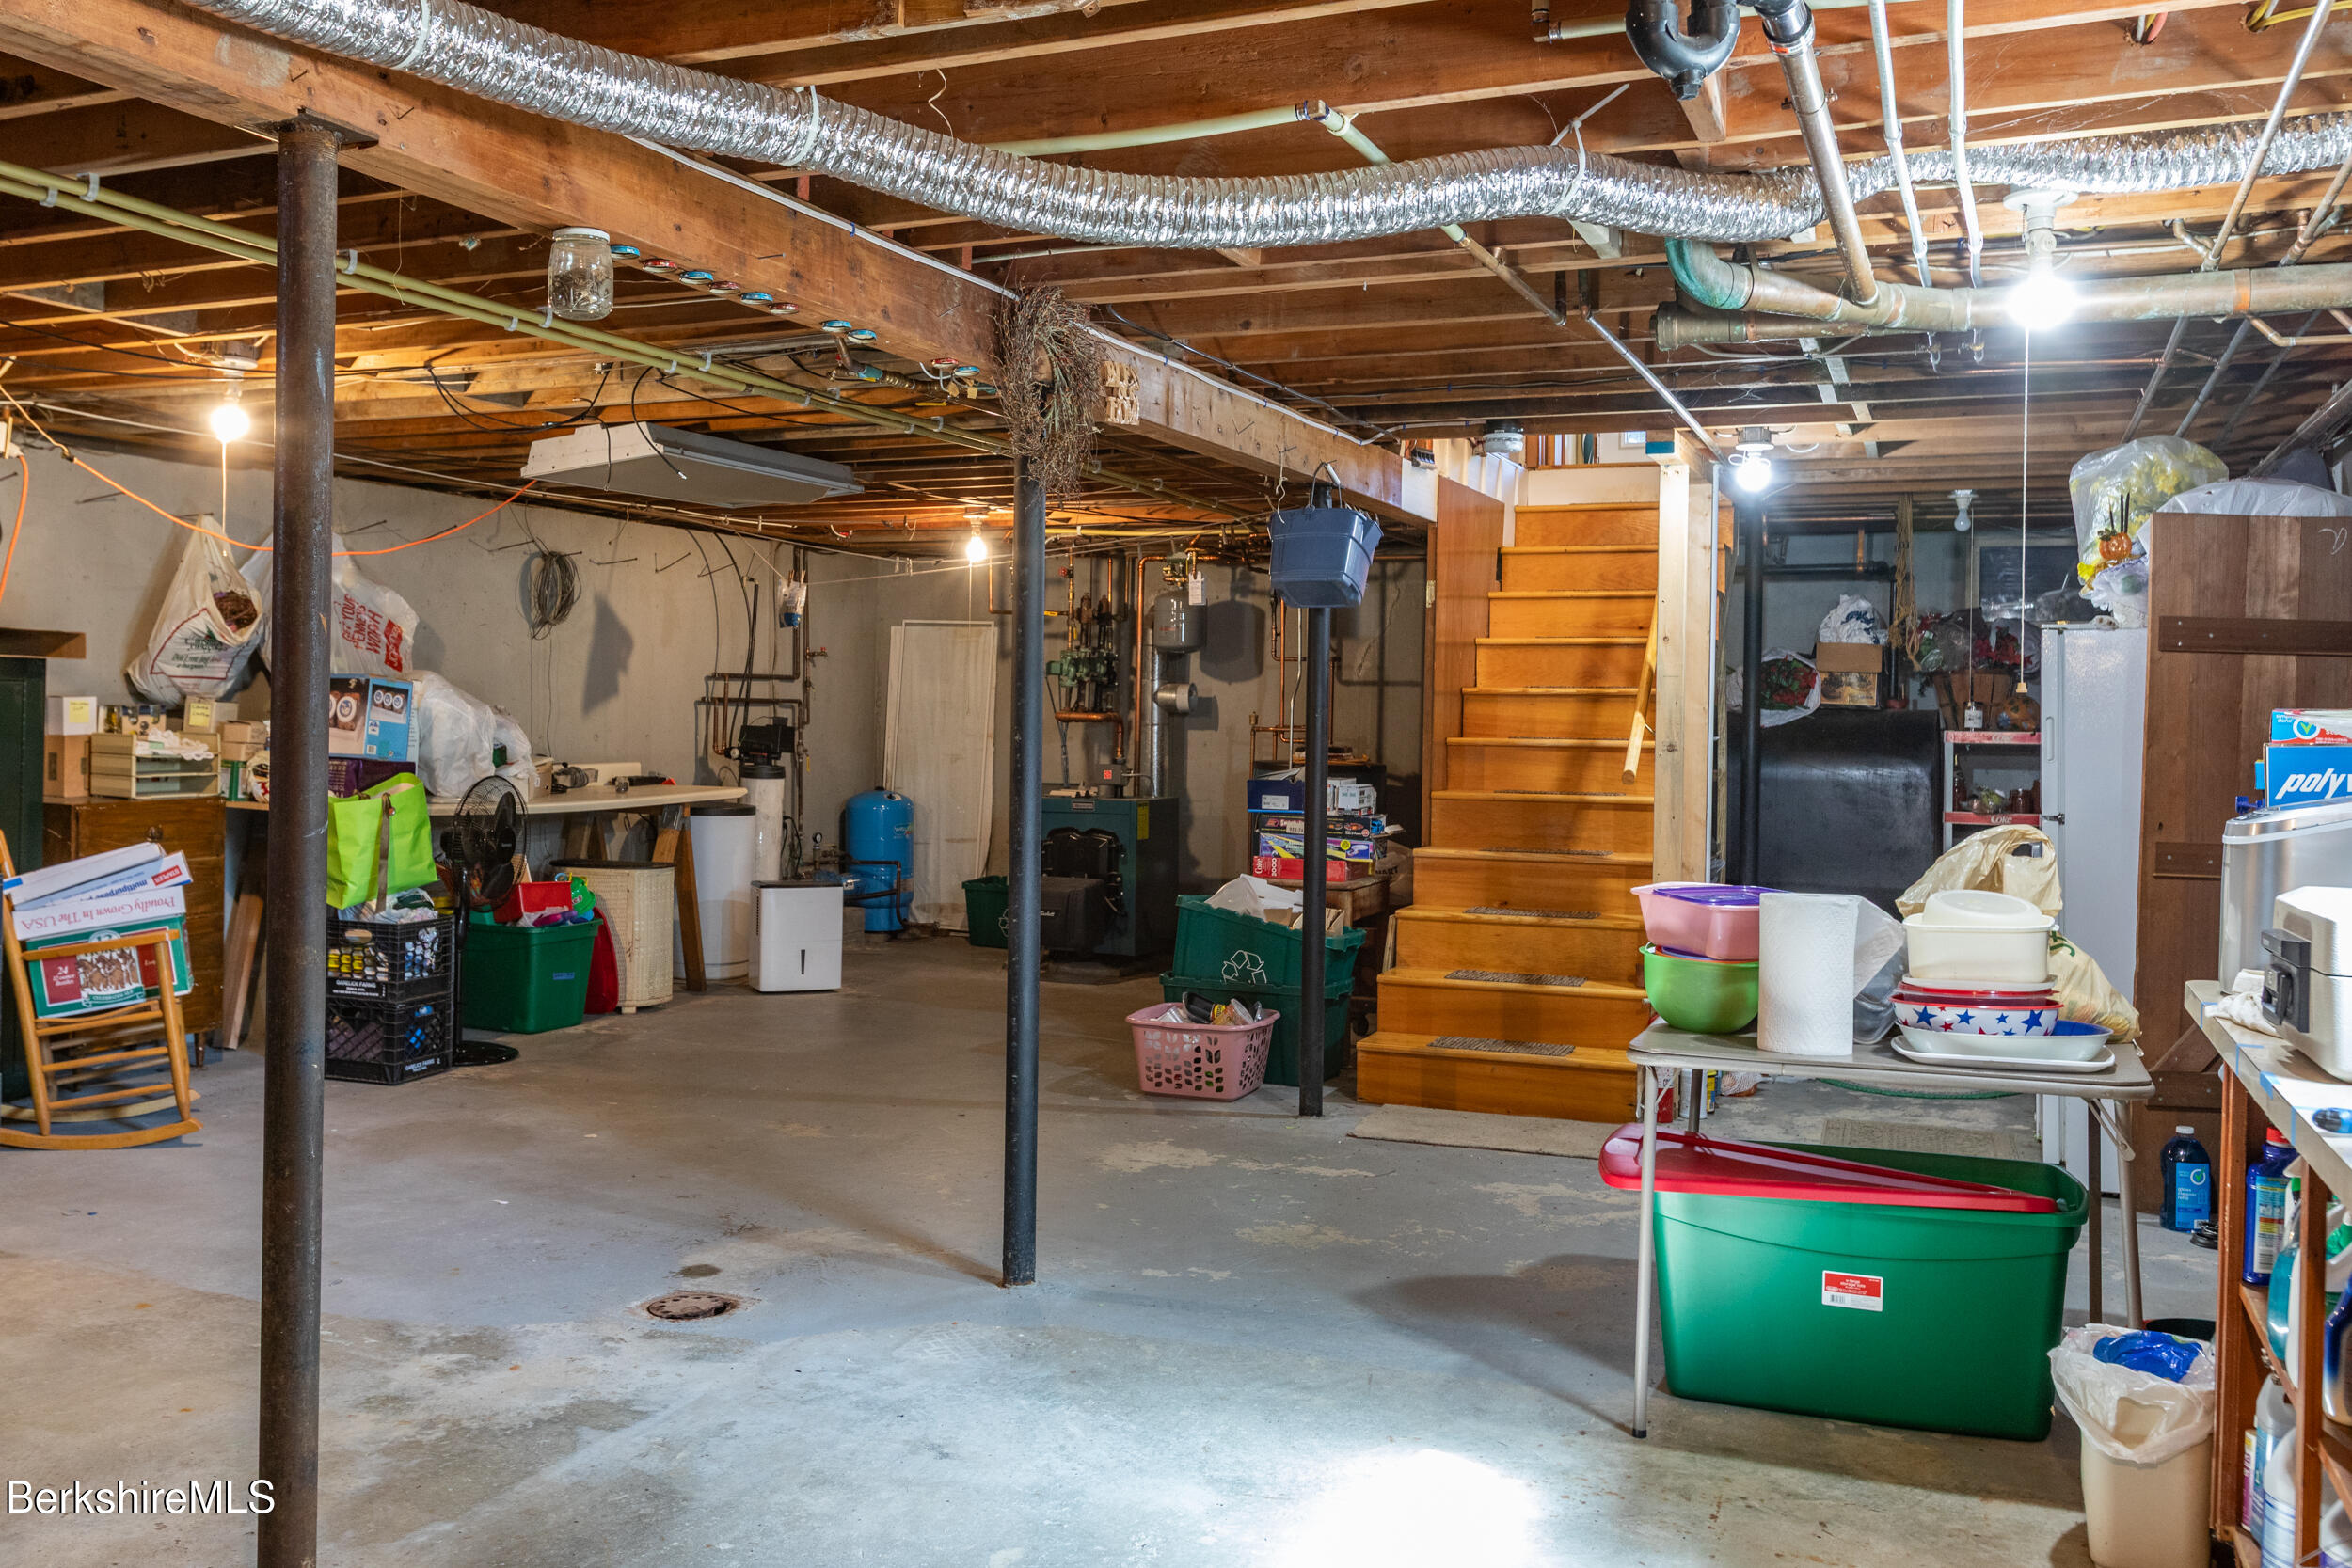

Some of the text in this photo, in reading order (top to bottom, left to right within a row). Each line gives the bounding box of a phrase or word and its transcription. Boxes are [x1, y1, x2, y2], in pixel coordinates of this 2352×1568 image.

[1991, 815, 2012, 824] Coke
[21, 896, 176, 930] Proudly Grown In The USA
[57, 965, 69, 975] 24
